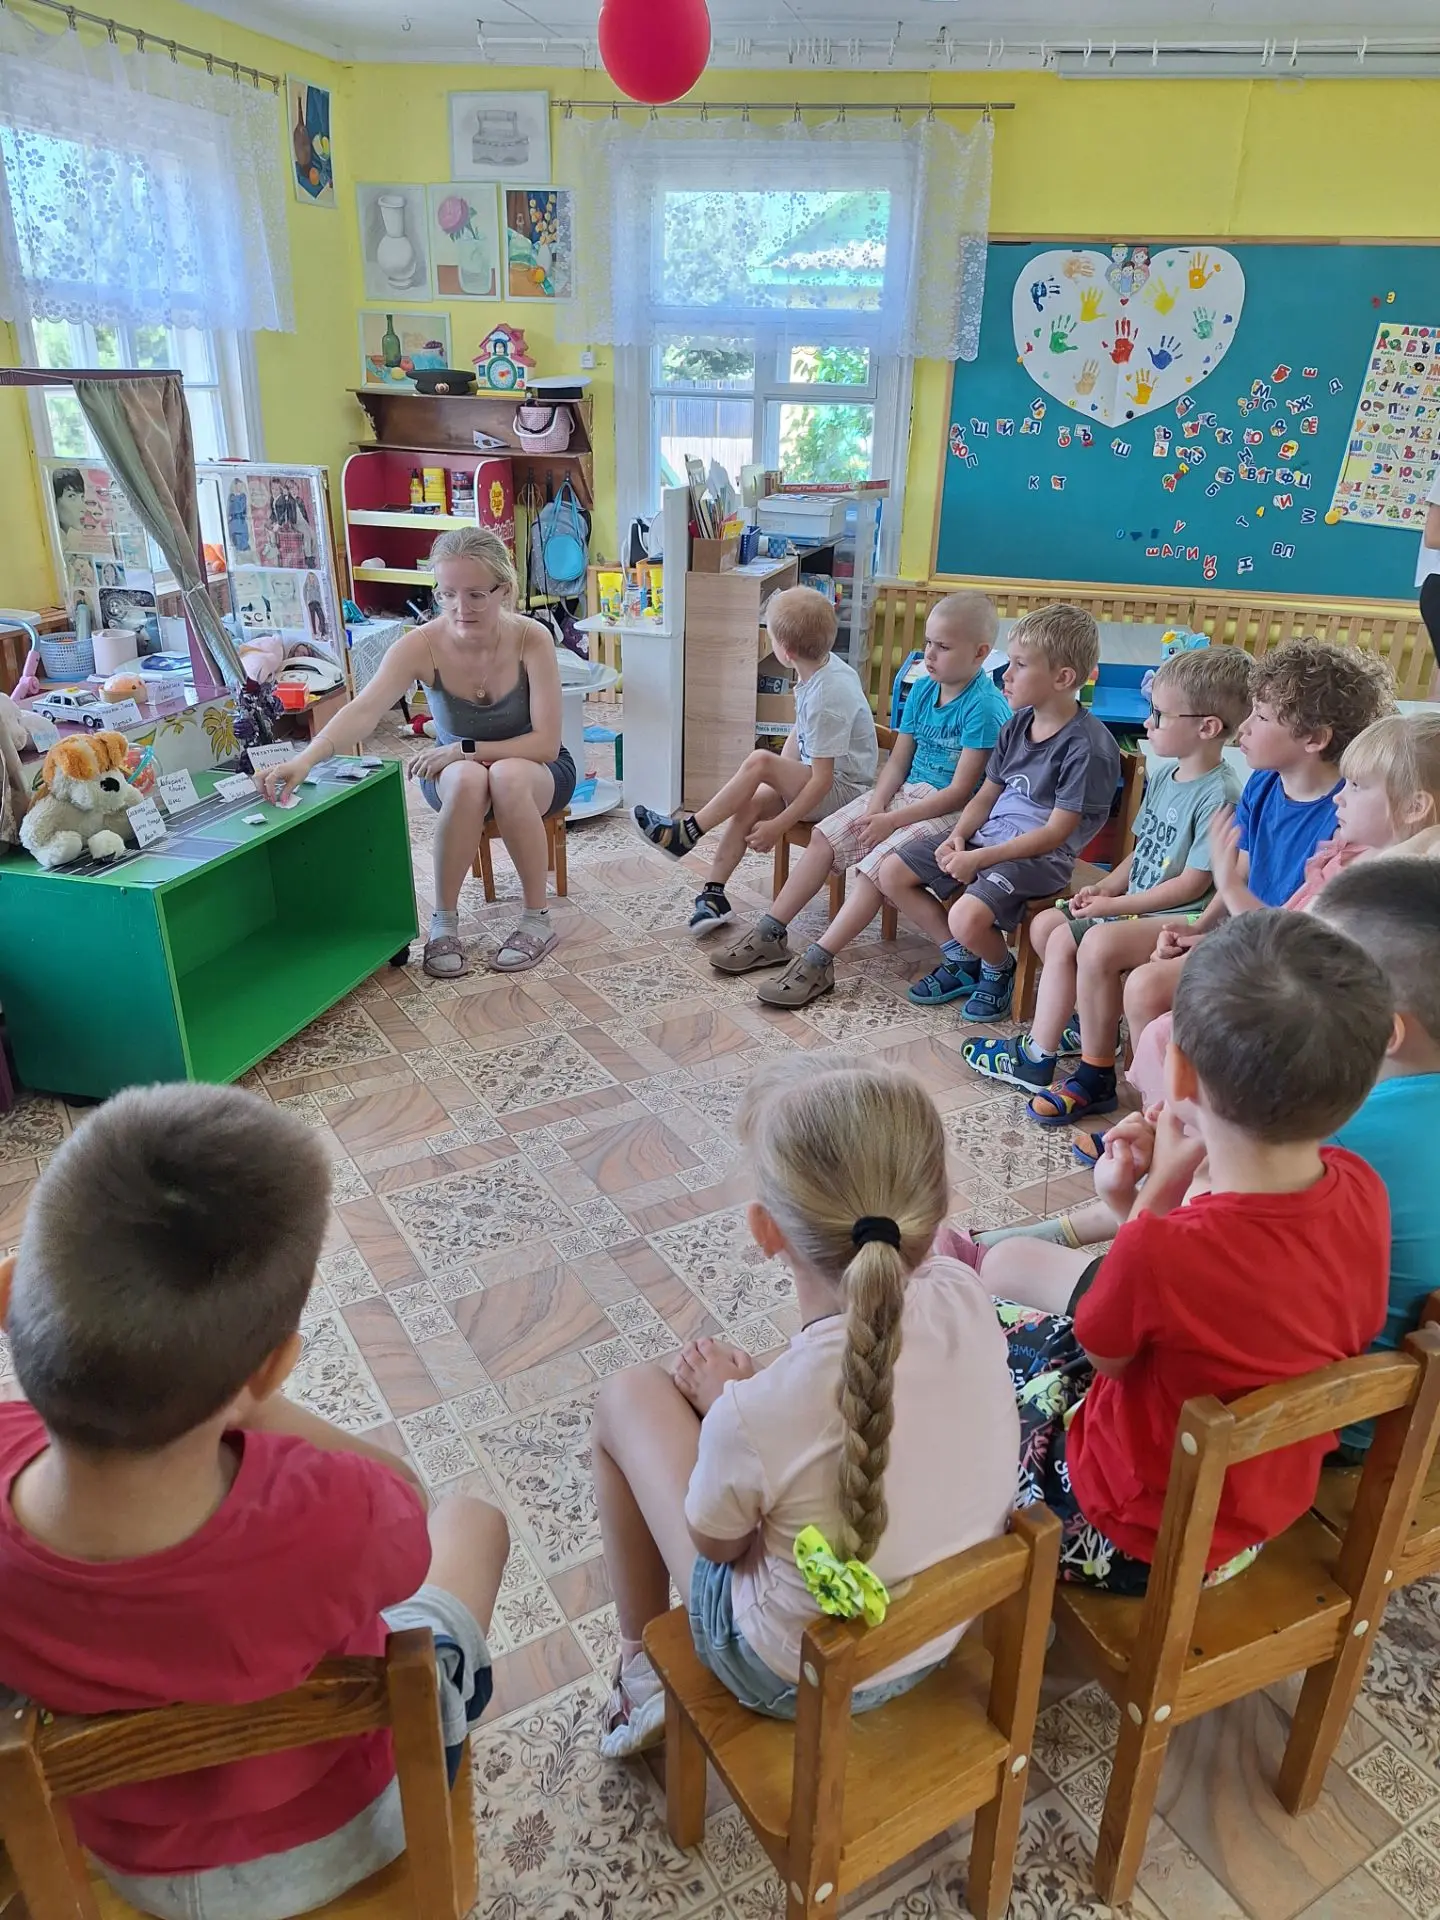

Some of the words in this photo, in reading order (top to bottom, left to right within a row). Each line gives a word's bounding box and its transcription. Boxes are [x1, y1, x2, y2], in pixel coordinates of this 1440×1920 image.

[1392, 381, 1405, 394] К
[1388, 403, 1398, 414] П
[1415, 406, 1426, 417] Р
[1030, 477, 1039, 489] К
